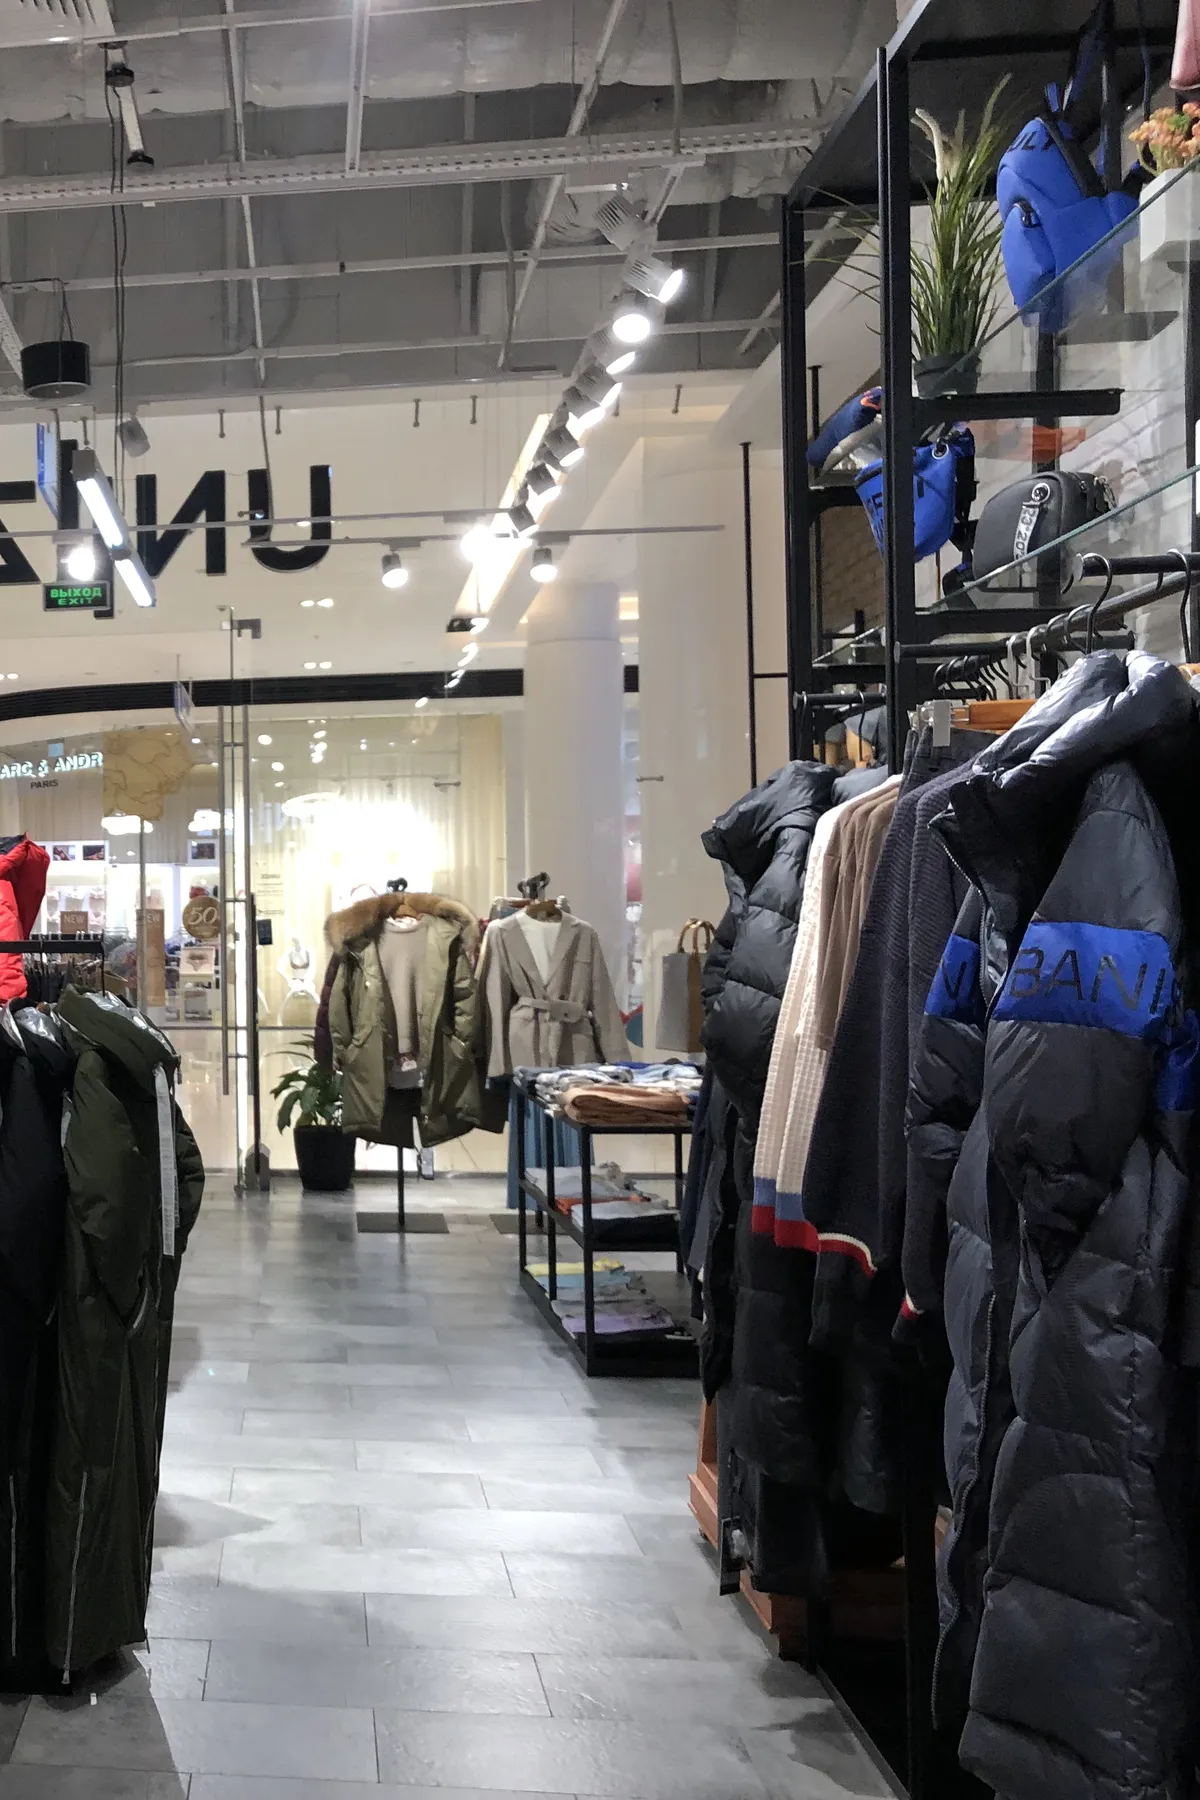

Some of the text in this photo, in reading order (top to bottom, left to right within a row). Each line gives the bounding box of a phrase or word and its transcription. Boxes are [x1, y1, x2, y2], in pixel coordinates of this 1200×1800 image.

[50, 587, 102, 598] ВЫХОД
[57, 597, 94, 605] EXIT
[54, 752, 104, 773] ANDR
[30, 780, 59, 789] PARIS
[63, 914, 85, 924] NEW
